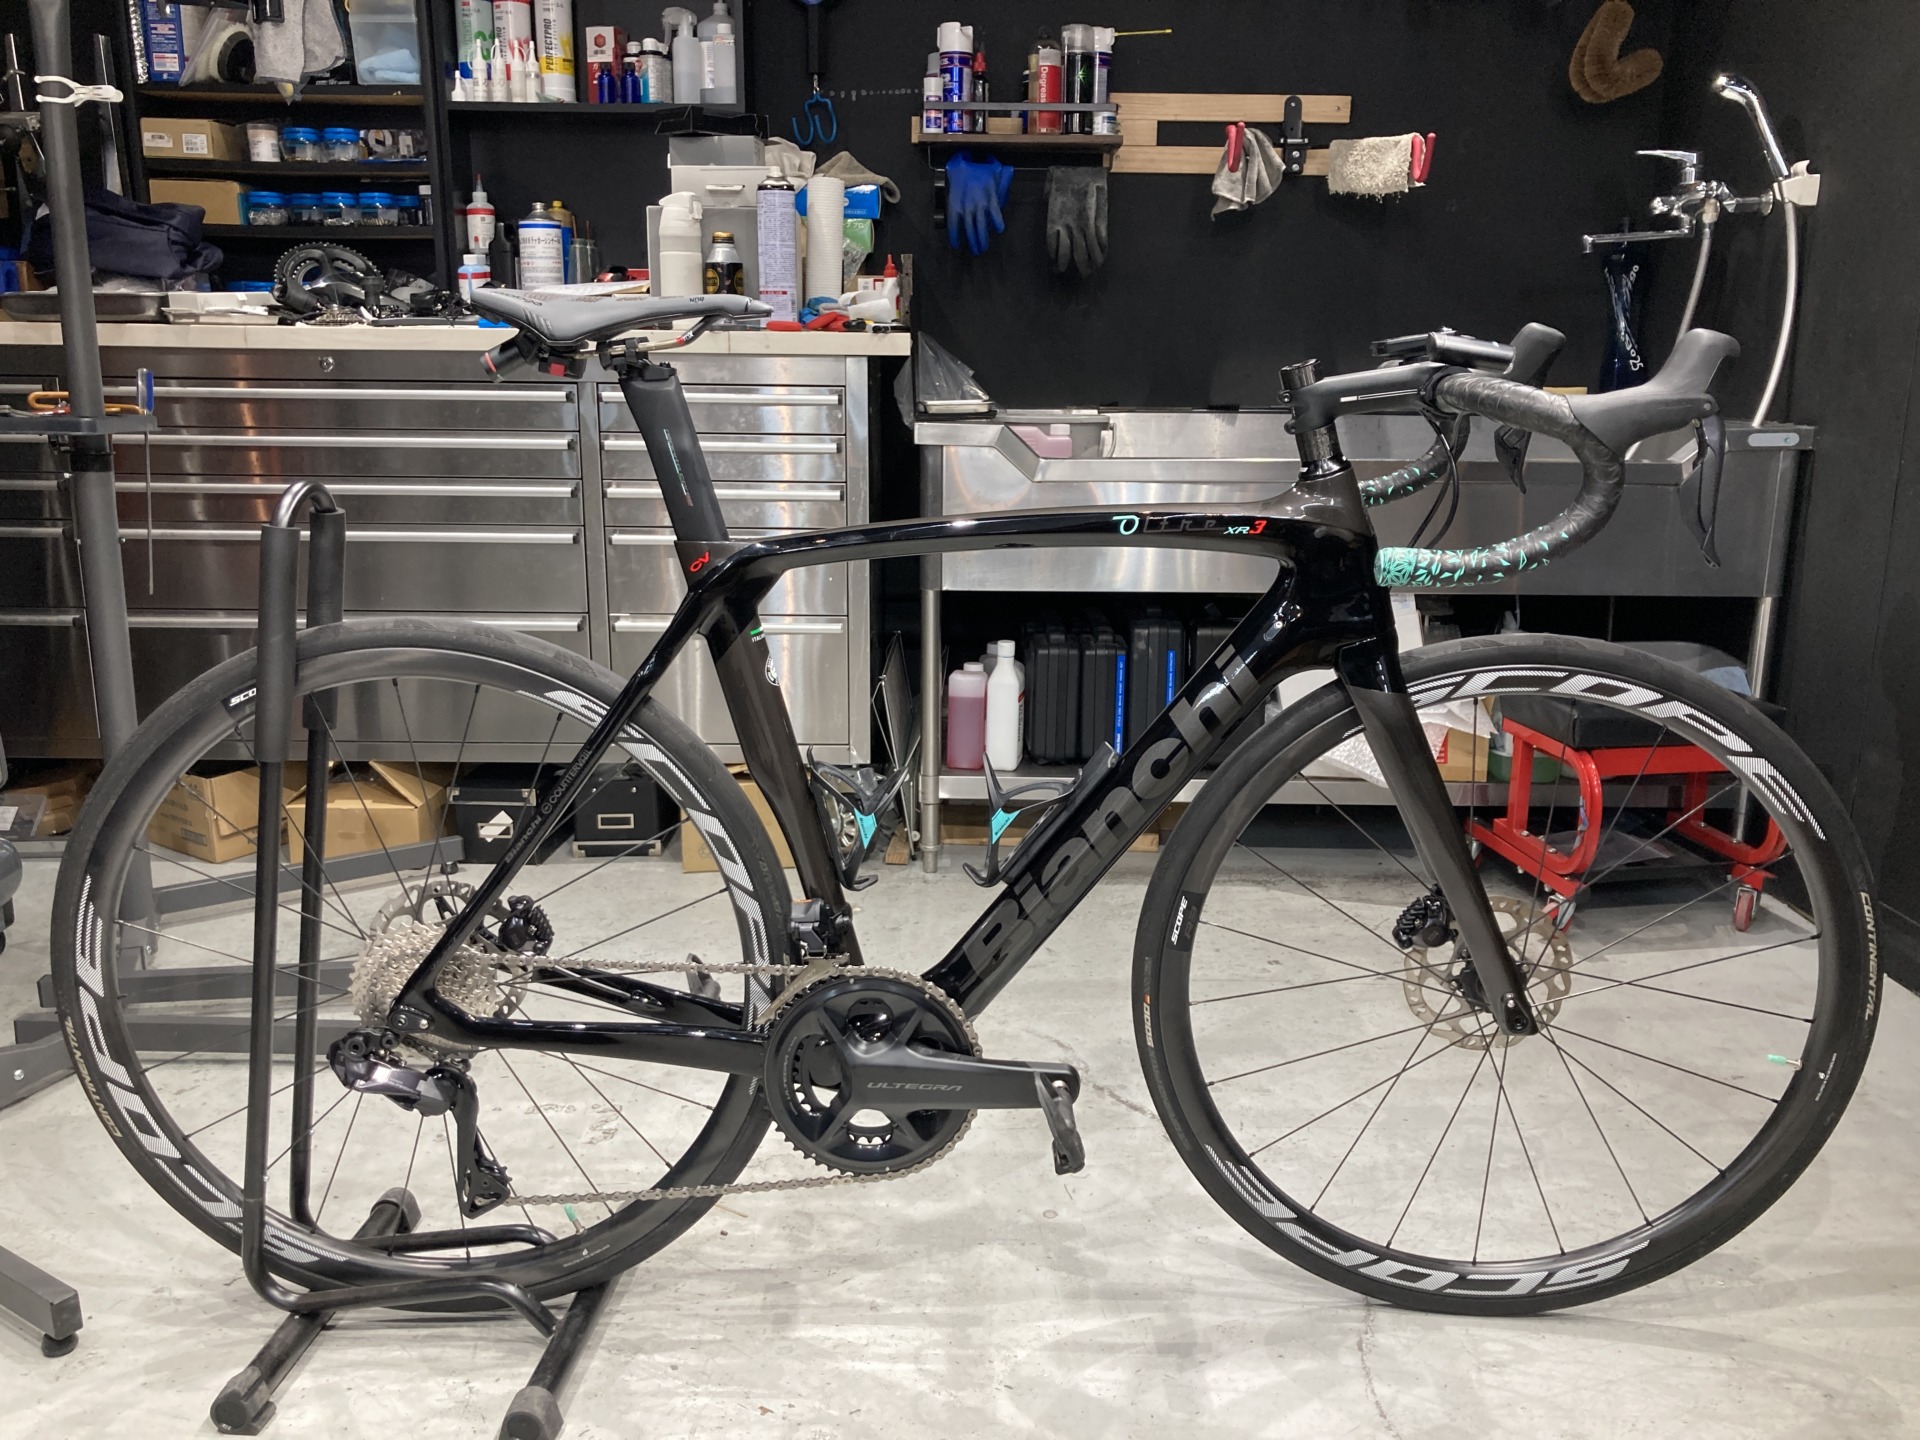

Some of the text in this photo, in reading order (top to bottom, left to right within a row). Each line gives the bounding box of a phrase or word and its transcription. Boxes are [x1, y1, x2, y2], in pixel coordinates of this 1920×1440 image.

[542, 18, 554, 71] PERFECTPRO
[1223, 520, 1268, 535] XR3
[229, 687, 257, 707] SCO
[549, 746, 592, 805] COUNTERVAIL
[504, 814, 543, 866] Bianchi
[962, 643, 1262, 990] Bianchi
[1169, 895, 1189, 945] SCOPE
[1860, 891, 1878, 1021] CONTINENTAL
[1142, 1002, 1155, 1048] 5000
[64, 1015, 123, 1139] CONTINENTAL
[866, 1080, 963, 1093] ULTEGRA
[1204, 1143, 1650, 1297] SCOPE
